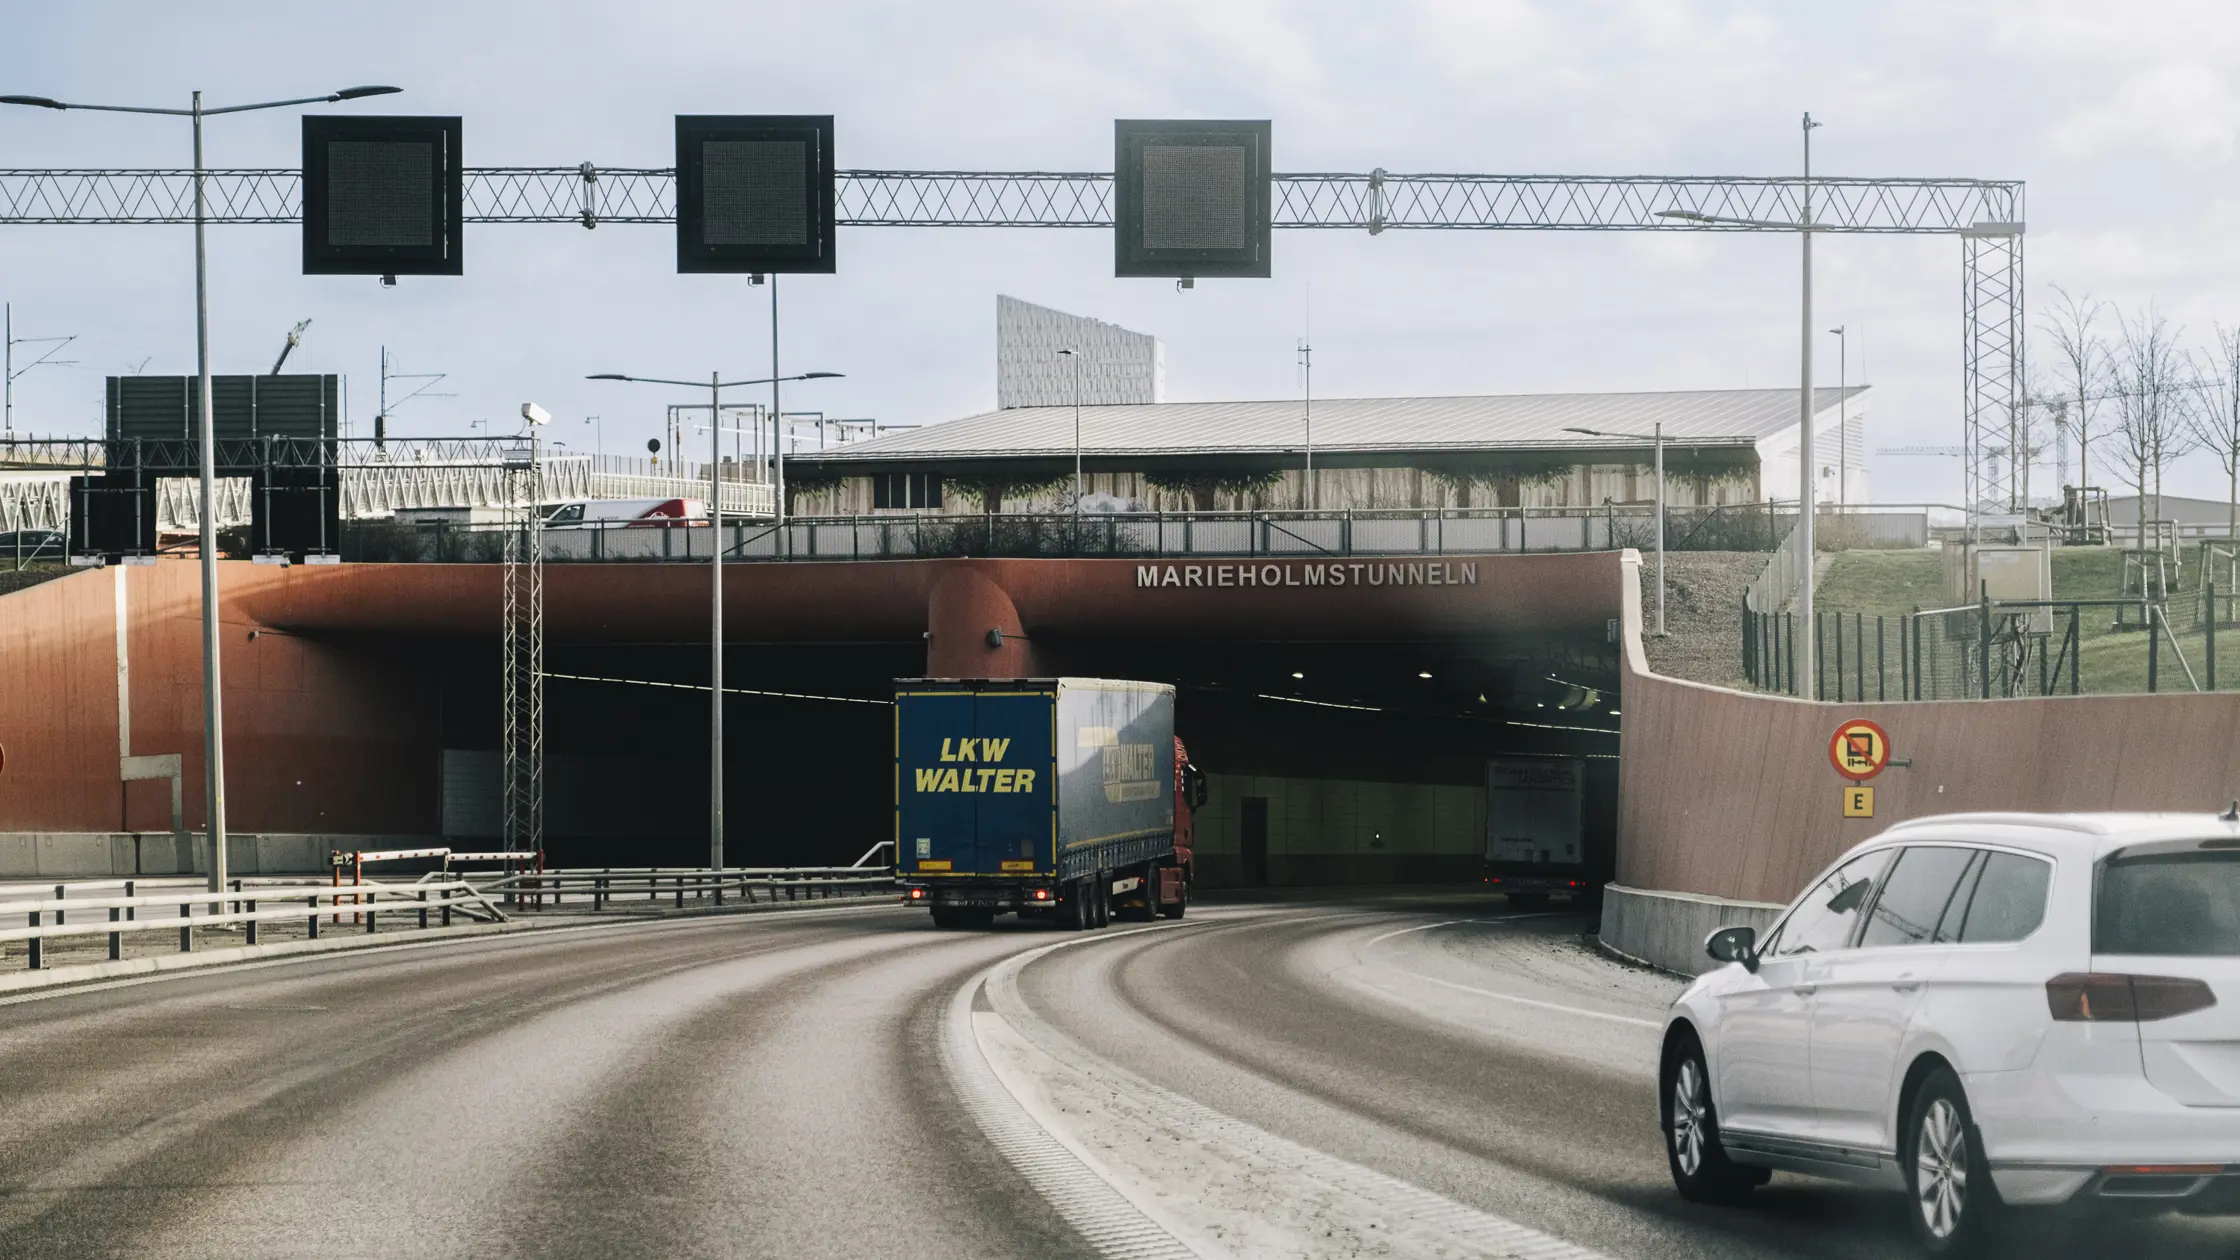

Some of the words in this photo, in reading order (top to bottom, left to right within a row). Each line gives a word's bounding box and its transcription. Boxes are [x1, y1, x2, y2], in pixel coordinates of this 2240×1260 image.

[1136, 562, 1477, 587] MARIEHOLMSTUNNELN
[940, 738, 1011, 762] LKW
[915, 768, 1036, 793] WALTER
[1854, 793, 1863, 809] E
